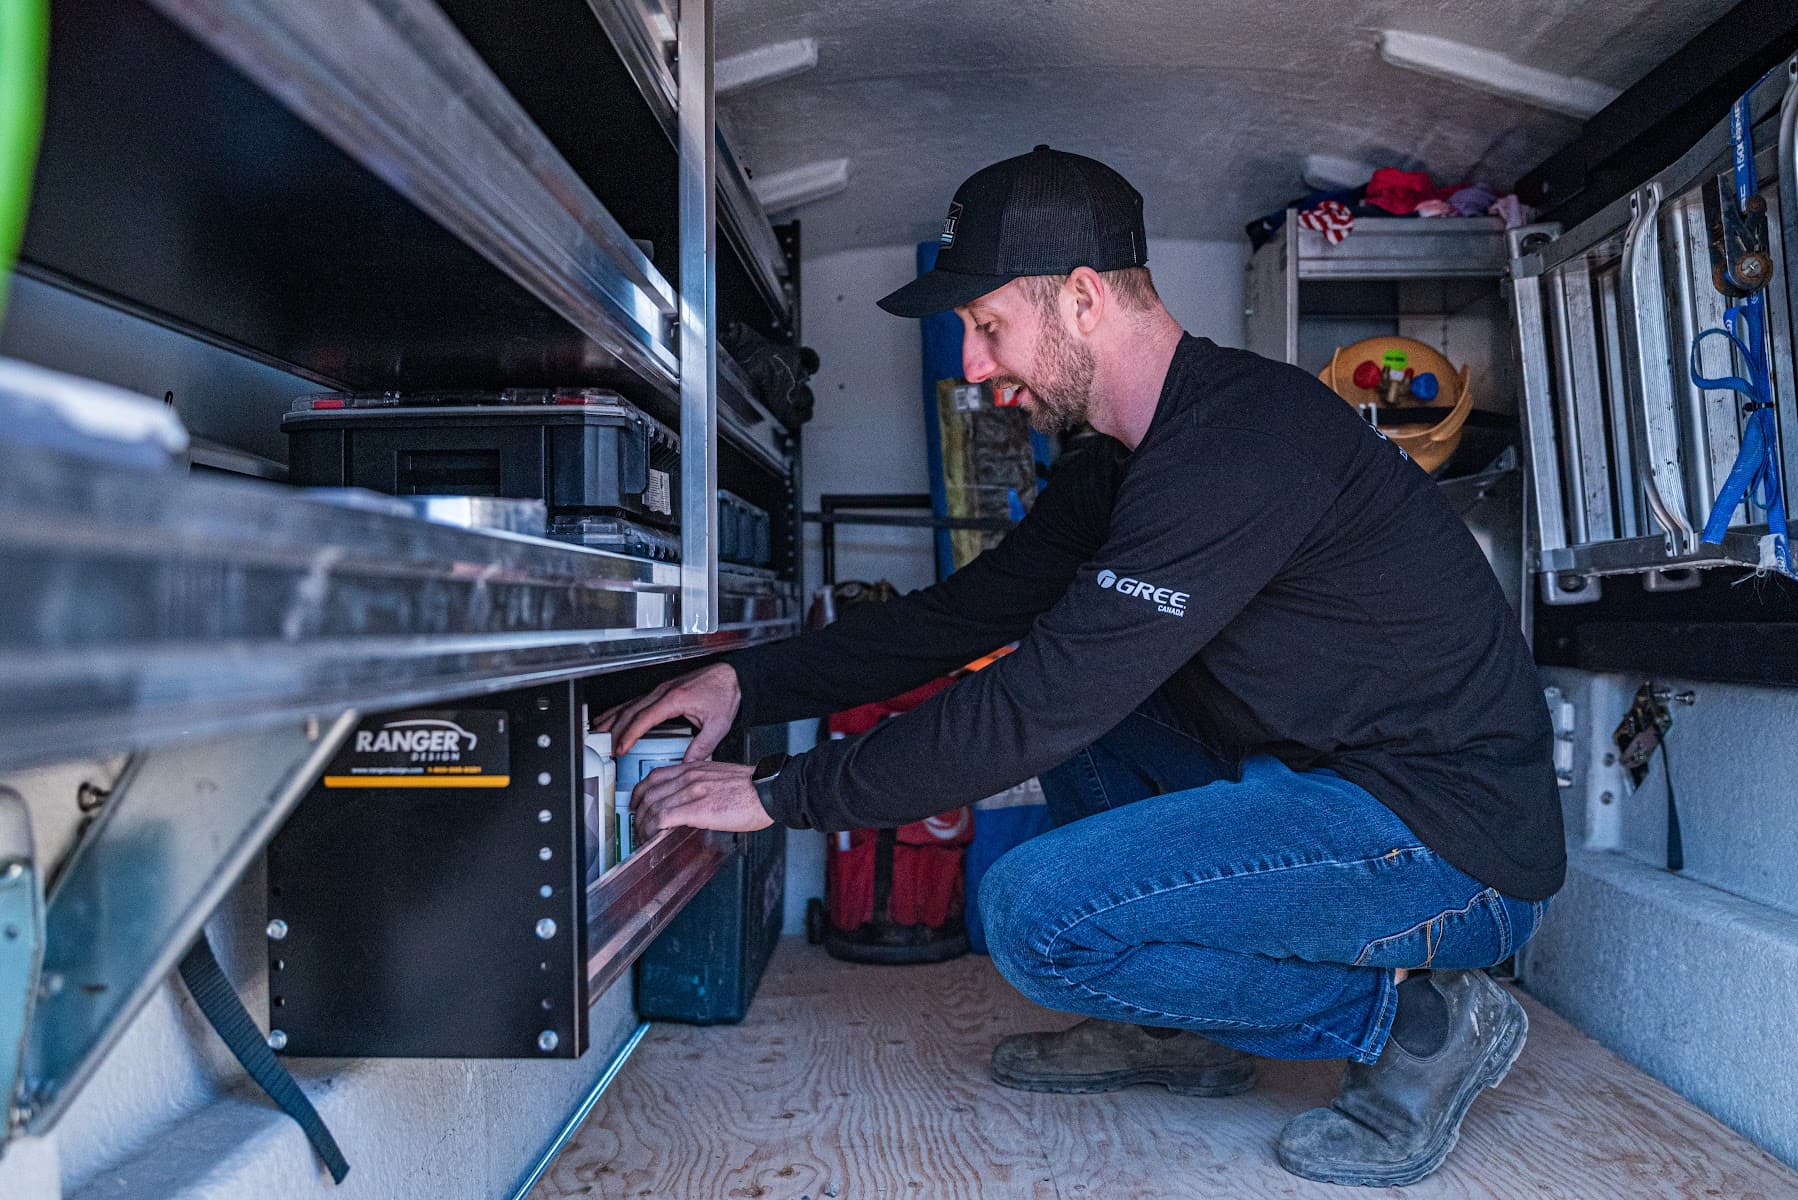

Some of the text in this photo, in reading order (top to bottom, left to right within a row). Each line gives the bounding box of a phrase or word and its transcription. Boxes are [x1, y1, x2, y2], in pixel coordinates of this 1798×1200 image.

[1116, 577, 1190, 609] GREE
[1157, 604, 1185, 617] CANADA
[356, 730, 460, 752] RANGER
[411, 752, 460, 762] DESIGN
